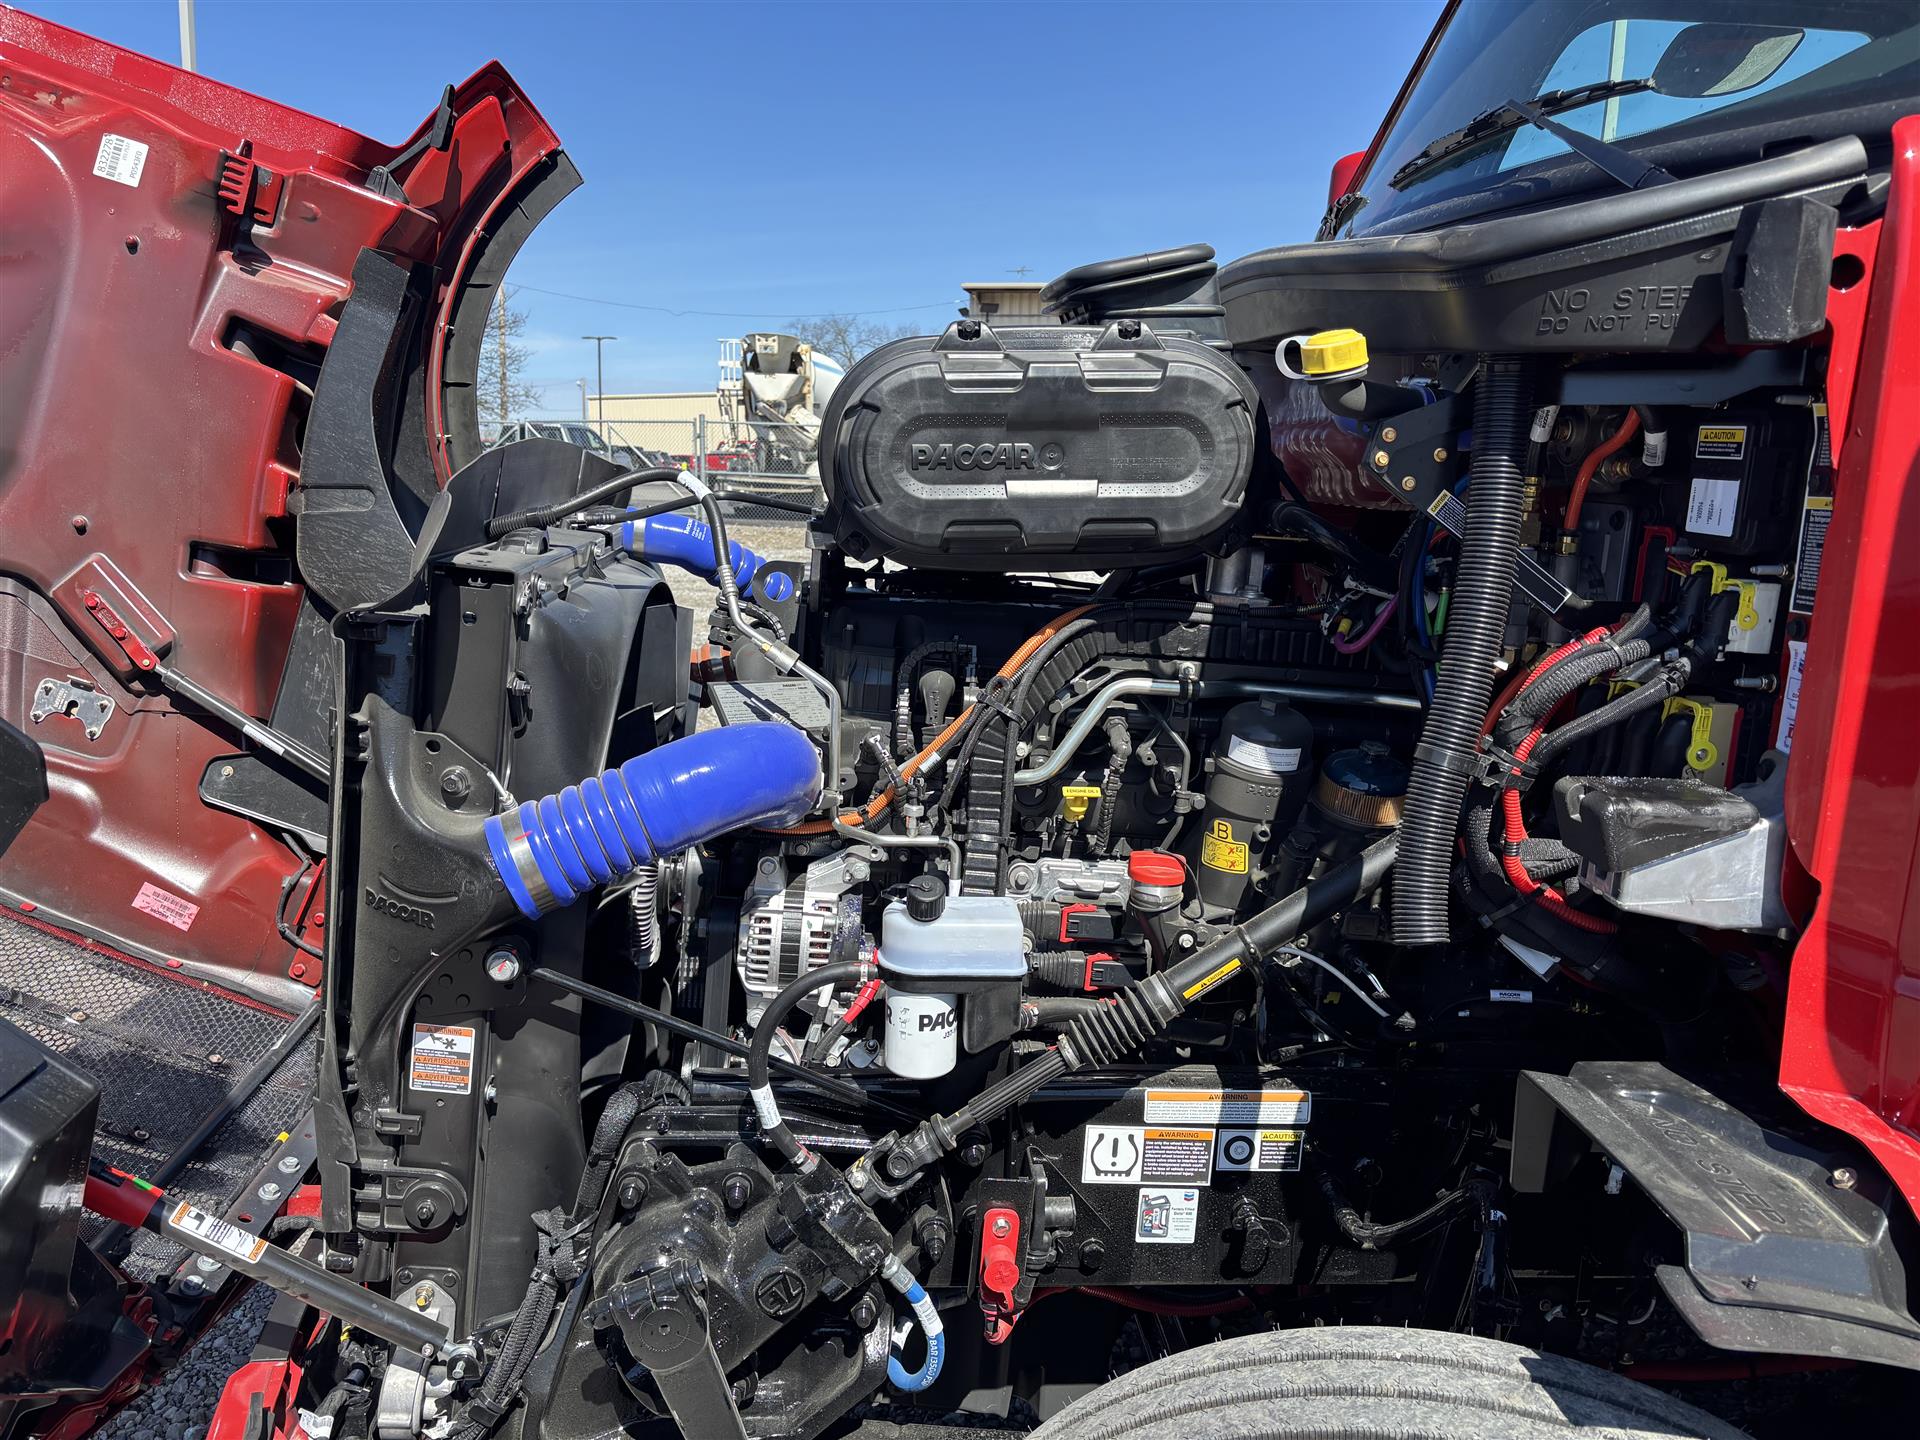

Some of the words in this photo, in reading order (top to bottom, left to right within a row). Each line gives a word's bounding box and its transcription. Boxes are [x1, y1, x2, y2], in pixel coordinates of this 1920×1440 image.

[97, 138, 113, 173] 832278
[1541, 288, 1590, 315] NO
[1536, 316, 1570, 336] DO
[1584, 314, 1632, 333] NOT
[1710, 431, 1736, 440] CAUTION
[911, 443, 1035, 471] PACCAR
[1431, 492, 1448, 513] CAUTION
[1217, 821, 1229, 840] B
[366, 886, 436, 930] PACCAR
[1207, 969, 1225, 983] CAUTION
[434, 1027, 463, 1036] WARNING
[423, 1057, 469, 1066] AVERTISSEMENT
[424, 1073, 466, 1082] ADVERTENCIA
[1164, 1131, 1199, 1139] WARNING
[1650, 1118, 1699, 1147] NO
[1695, 1159, 1787, 1225] STEP
[929, 1339, 938, 1356] BAR
